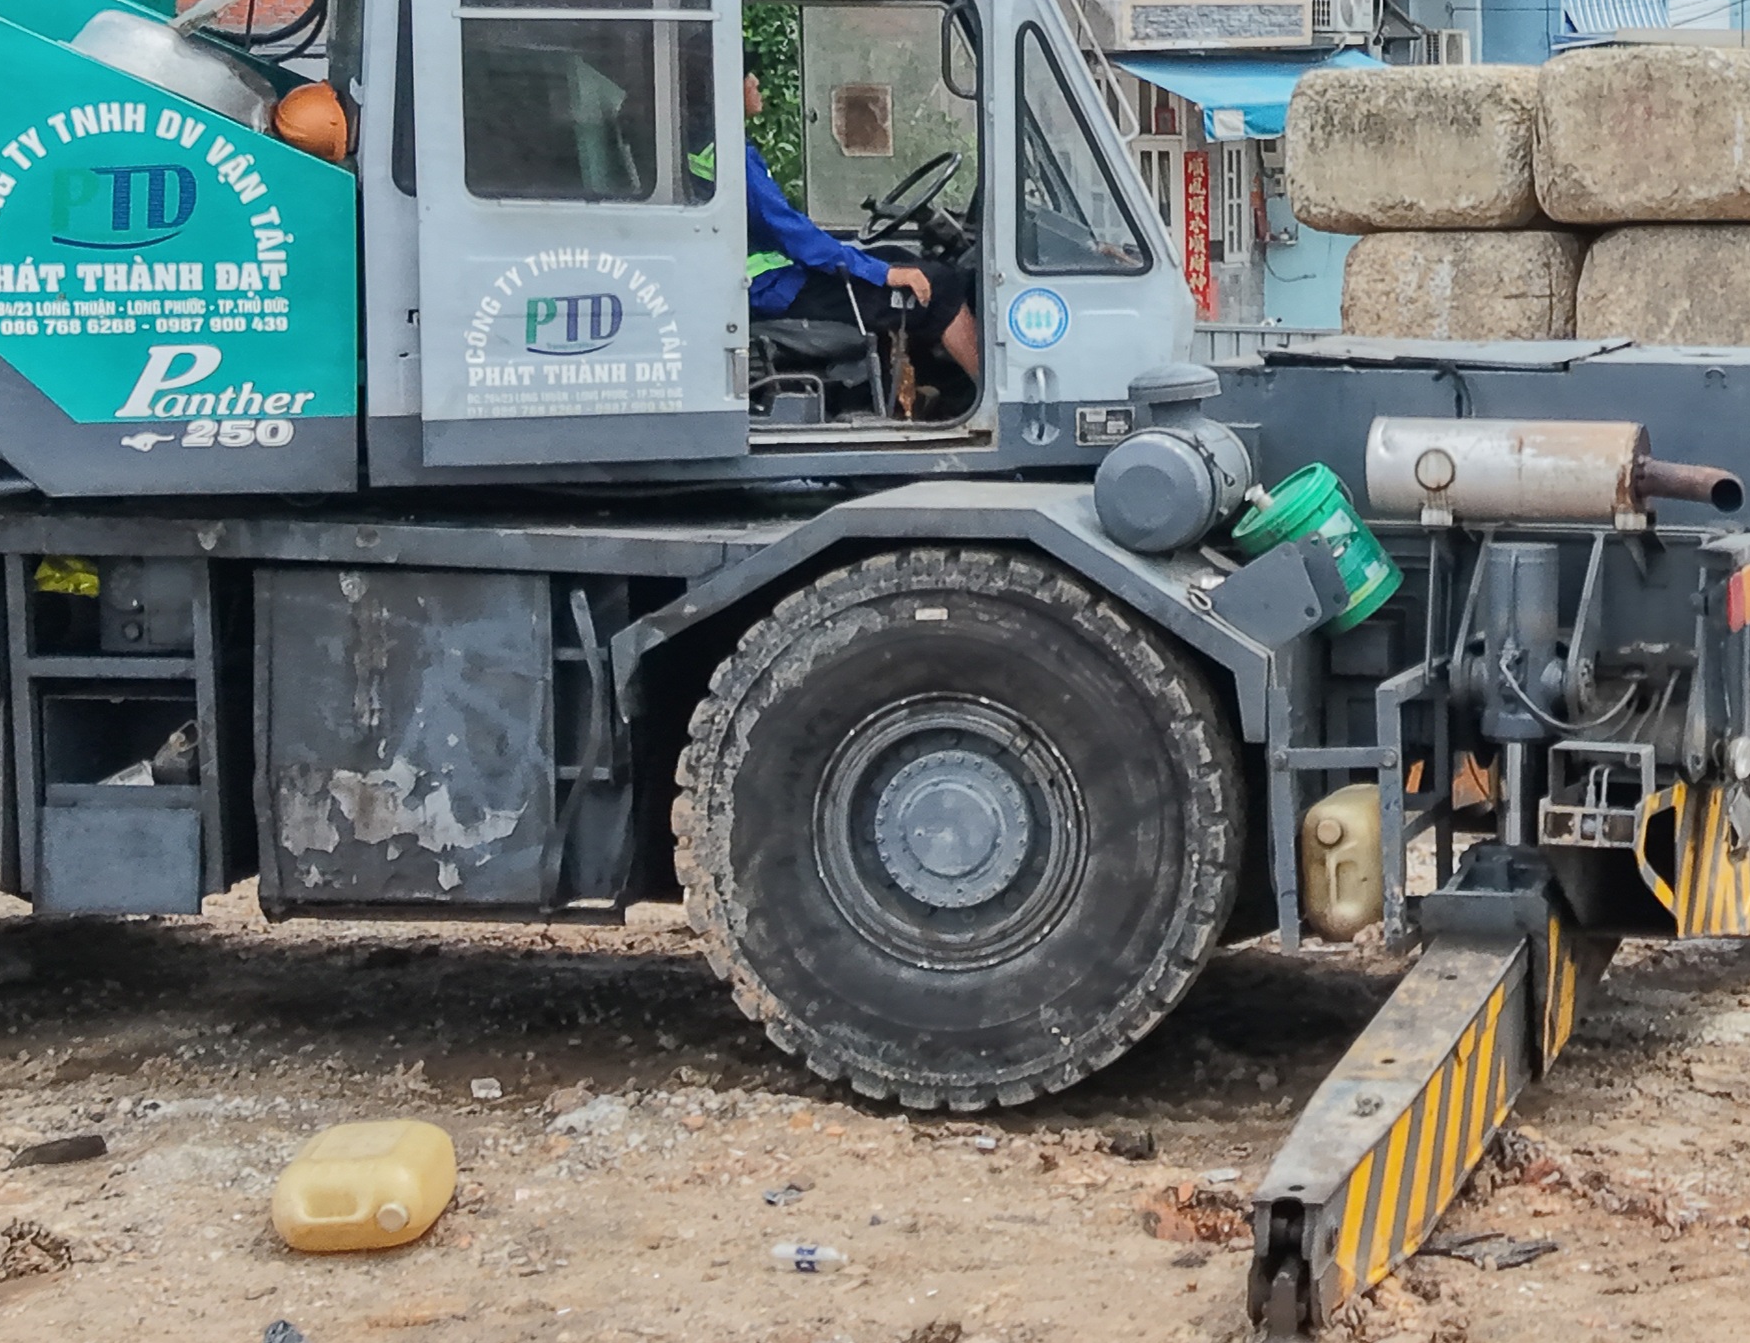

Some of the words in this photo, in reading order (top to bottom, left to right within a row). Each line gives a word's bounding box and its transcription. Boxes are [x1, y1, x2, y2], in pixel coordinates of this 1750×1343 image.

[1, 127, 47, 170] TY
[47, 102, 146, 144] TNHH
[155, 108, 207, 149] DV
[206, 135, 268, 204] VẬN
[249, 206, 294, 261] TẢI
[51, 164, 197, 232] PTD
[76, 255, 203, 291] THÀNH
[215, 262, 287, 298] ĐẠT
[1, 319, 39, 335] 086
[43, 319, 81, 335] 768
[155, 316, 204, 333] 0987
[209, 316, 246, 332] 900
[251, 316, 288, 331] 439
[463, 296, 501, 364] CÔNG
[494, 266, 523, 296] TY
[524, 247, 589, 277] TNHH
[596, 251, 628, 280] DV
[628, 269, 669, 318] VẬN
[658, 320, 687, 359] TẢI
[525, 293, 623, 344] PTD
[115, 344, 314, 417] Panther
[468, 360, 535, 386] PHÁT
[543, 357, 626, 385] THÀNH
[181, 418, 295, 447] 250
